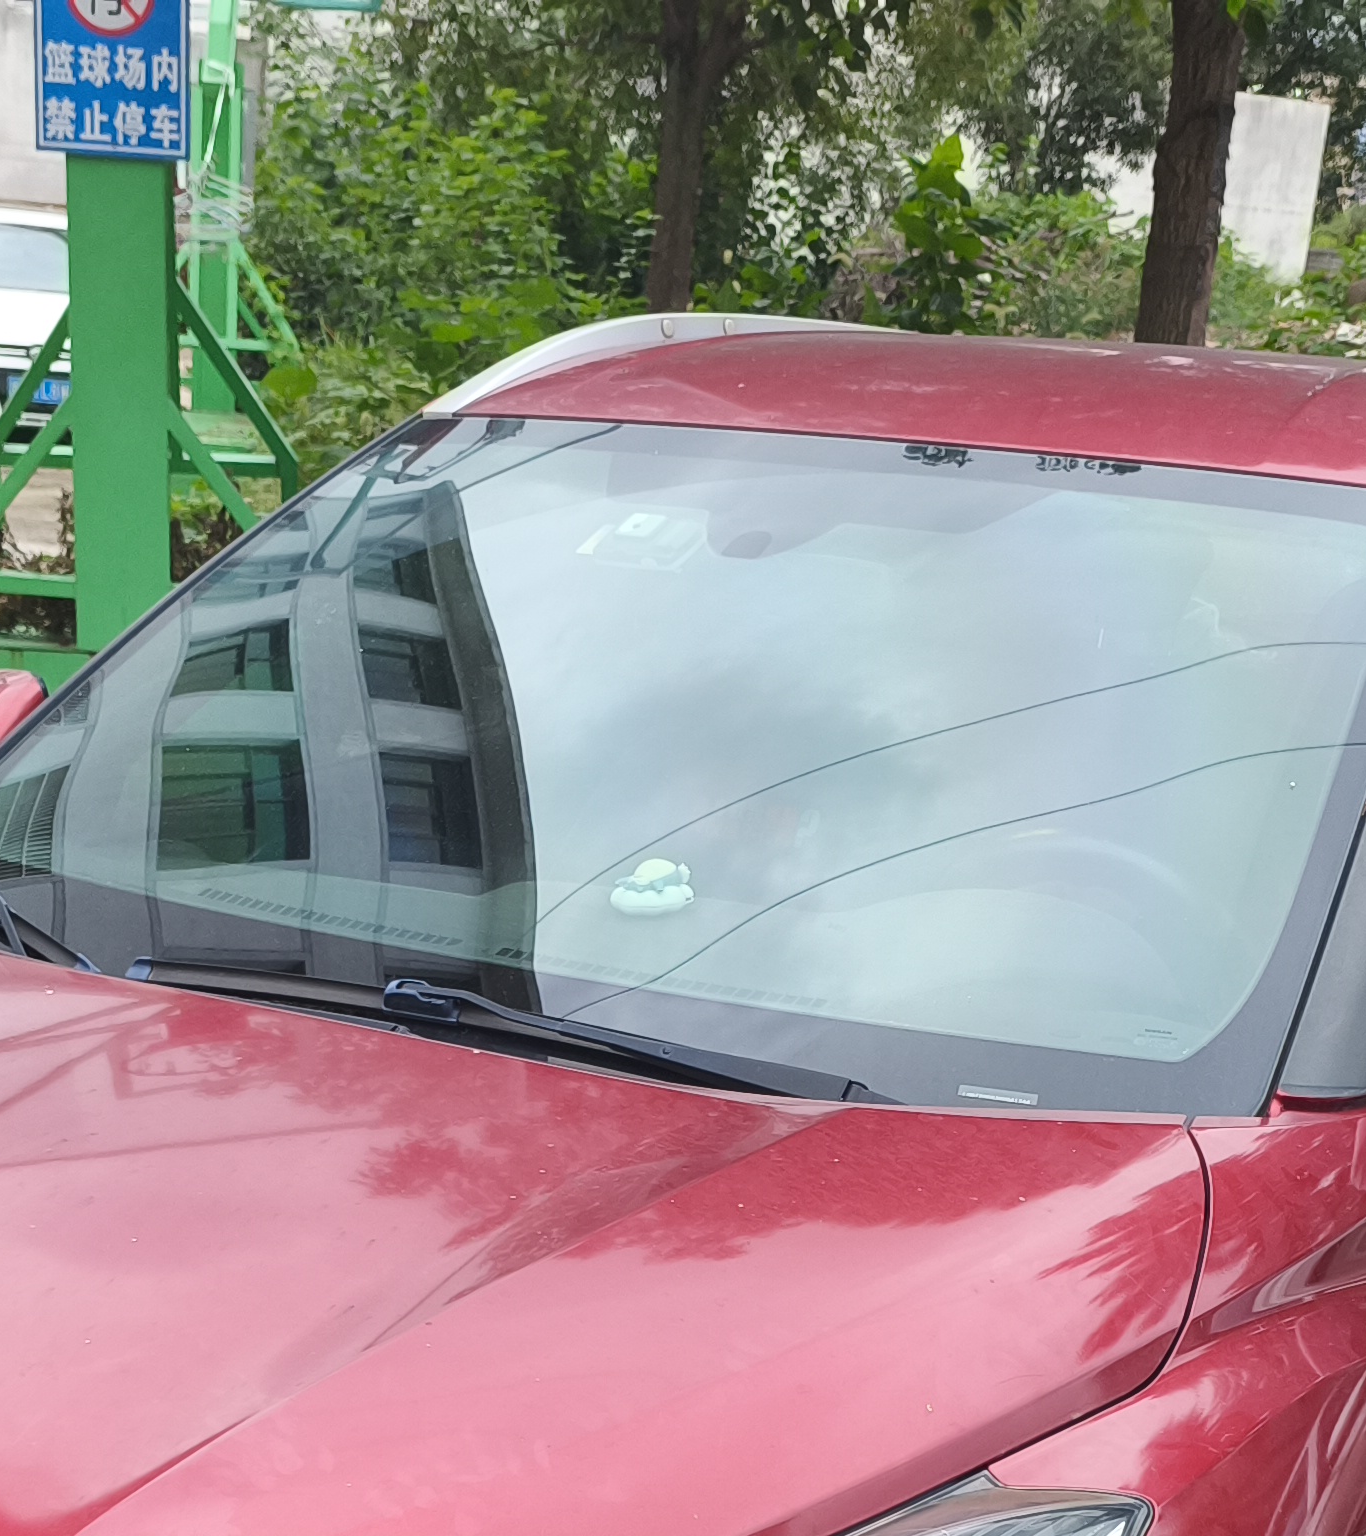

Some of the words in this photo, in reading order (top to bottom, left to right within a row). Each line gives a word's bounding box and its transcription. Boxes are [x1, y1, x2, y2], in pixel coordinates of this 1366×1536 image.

[43, 40, 179, 94] 篮球场内
[44, 97, 181, 149] 禁止停车
